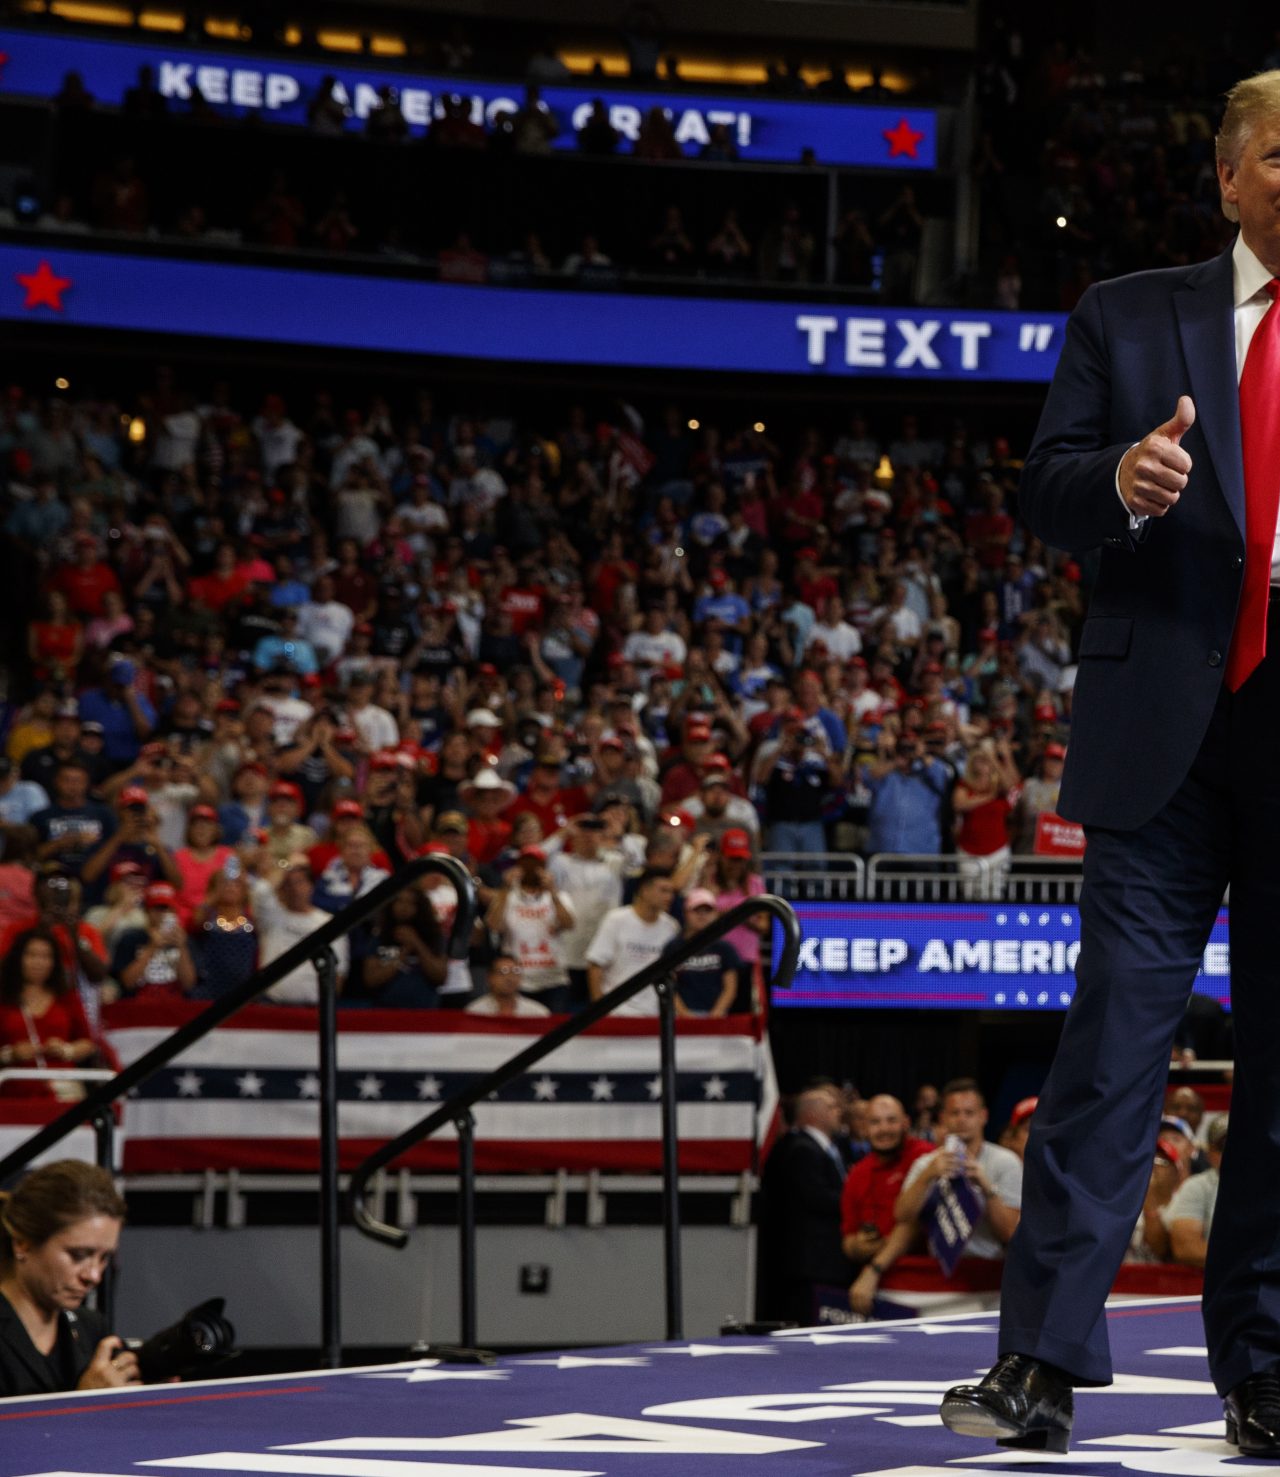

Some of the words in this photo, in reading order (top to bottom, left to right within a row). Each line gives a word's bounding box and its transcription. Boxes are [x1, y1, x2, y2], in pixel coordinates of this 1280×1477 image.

[158, 60, 300, 110] KEEP
[796, 314, 992, 370] TEXT
[795, 937, 909, 973] KEEP
[916, 938, 1081, 975] AMERI
